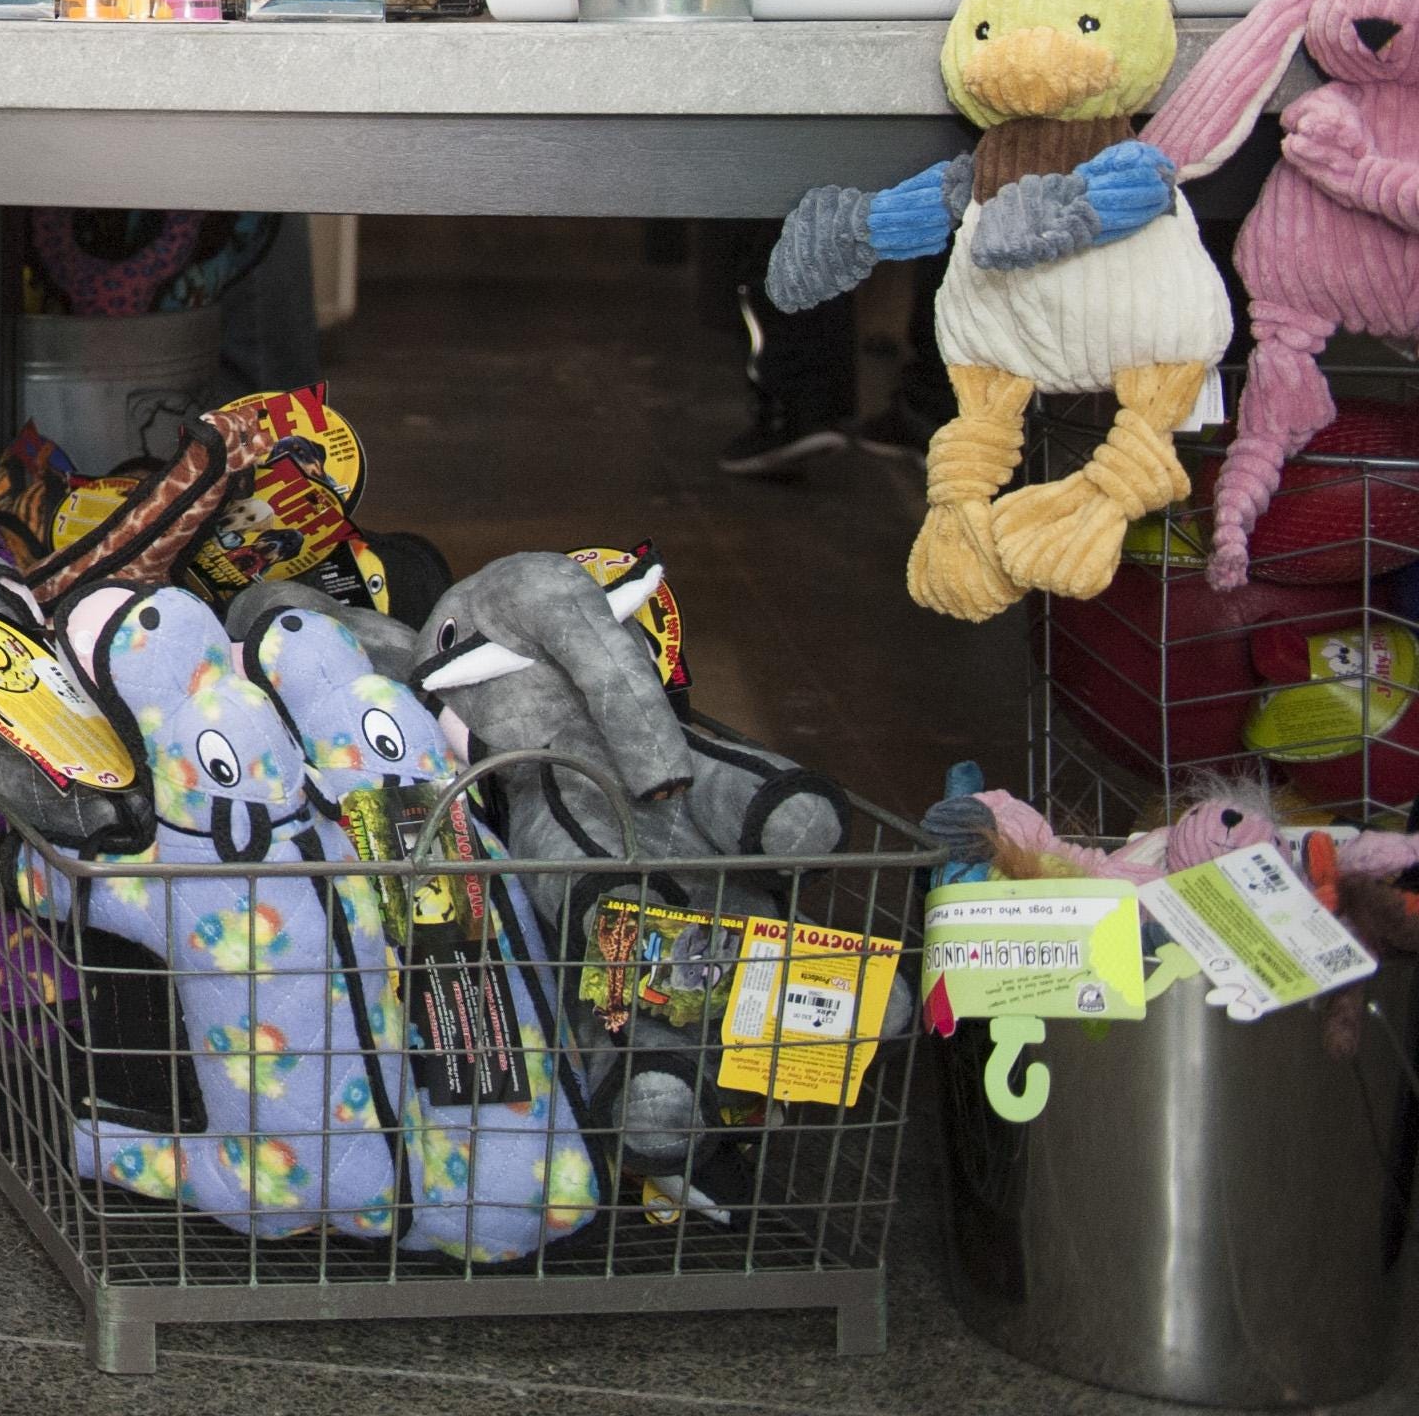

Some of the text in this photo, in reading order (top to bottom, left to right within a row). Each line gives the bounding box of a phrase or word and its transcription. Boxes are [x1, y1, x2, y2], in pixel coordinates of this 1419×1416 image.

[255, 457, 363, 553] TUFFY
[954, 904, 1076, 917] For Dogs Who Love to
[800, 972, 829, 985] Products
